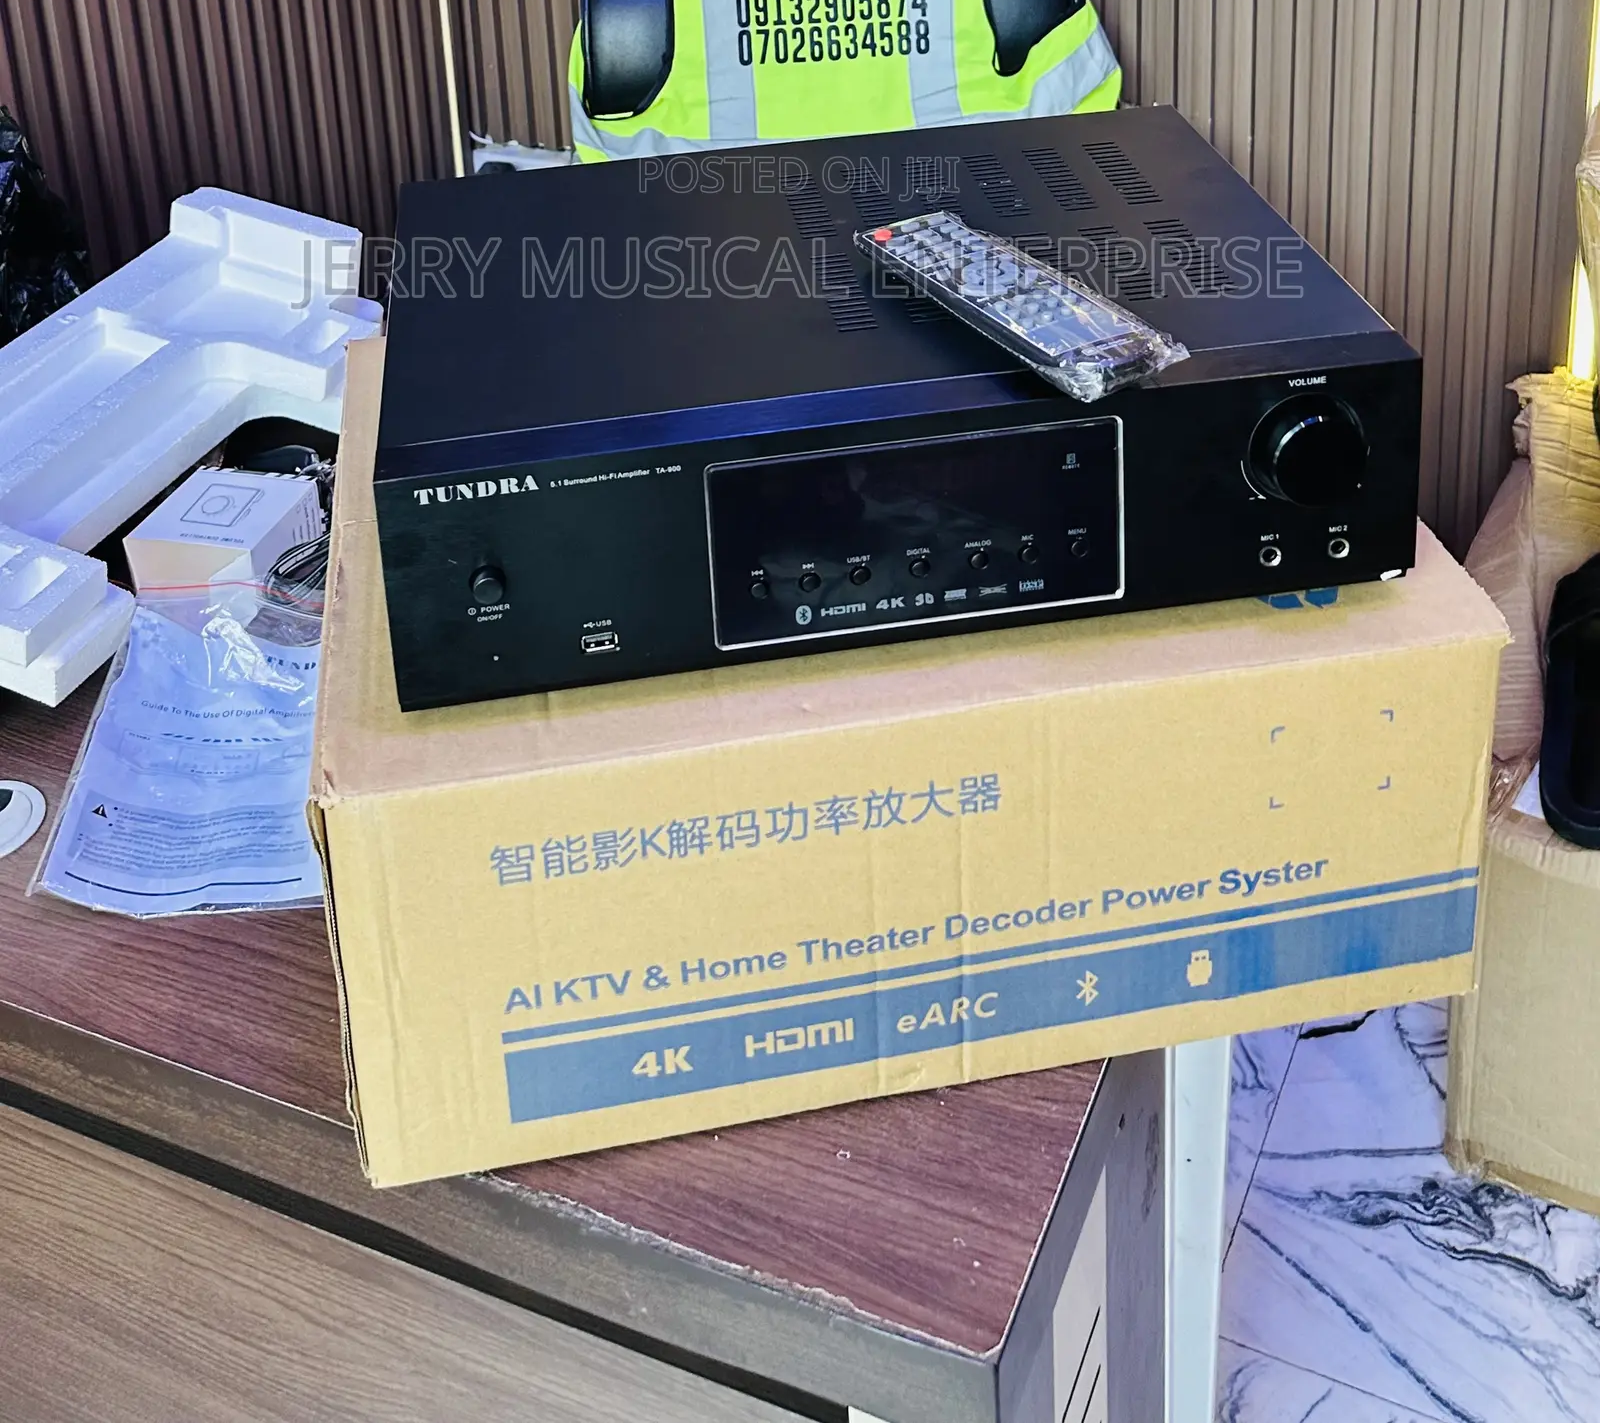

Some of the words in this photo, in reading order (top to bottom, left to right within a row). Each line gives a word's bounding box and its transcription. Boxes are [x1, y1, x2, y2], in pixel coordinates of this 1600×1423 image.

[737, 19, 930, 66] 07026634588
[1288, 375, 1328, 387] VOLUME
[413, 474, 540, 506] TUNDRA
[563, 476, 598, 486] Surround
[599, 473, 617, 481] Hi-Fi
[617, 468, 650, 479] Amplifier
[1021, 533, 1035, 542] MIC
[1067, 528, 1087, 536] MENU
[1260, 534, 1274, 542] MIC
[964, 539, 992, 549] ANALOG
[906, 546, 931, 557] DIGITAL
[846, 554, 871, 564] USB/BT
[480, 603, 511, 614] POWER
[820, 602, 867, 617] HDMI
[875, 596, 905, 610] 4K
[476, 613, 503, 623] ON/OFF
[595, 619, 612, 627] USB
[141, 699, 169, 713] Guide
[171, 706, 182, 715] To
[184, 708, 201, 719] The
[203, 710, 220, 719] Use
[222, 709, 234, 718] Of
[235, 708, 267, 718] Digital
[490, 773, 1002, 887] 智能影K解码功率放大器
[504, 983, 543, 1015] AI
[553, 969, 633, 1006] KTV
[642, 964, 671, 992] &
[680, 949, 788, 986] Home
[796, 924, 936, 967] Theater
[944, 896, 1094, 941] Decoder
[1100, 877, 1212, 916] Power
[631, 1045, 694, 1079] 4K
[744, 1017, 855, 1058] HDMI
[896, 991, 999, 1034] eARC
